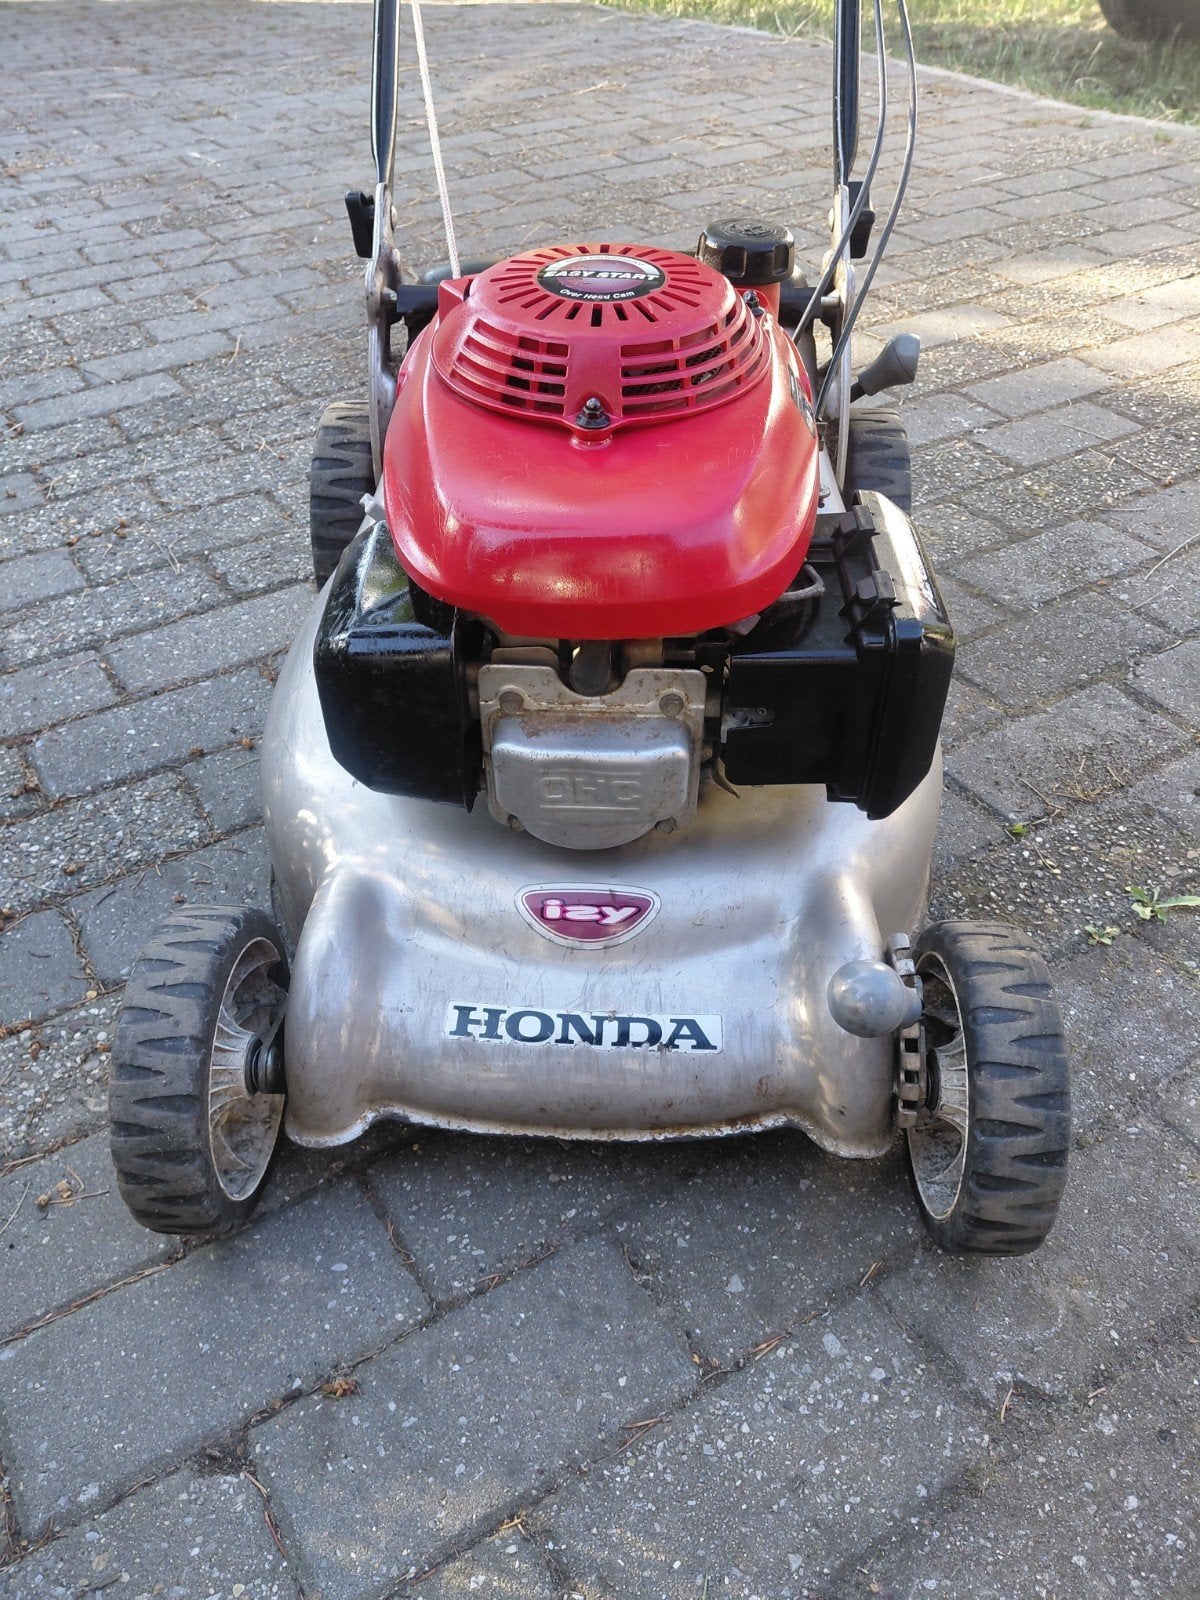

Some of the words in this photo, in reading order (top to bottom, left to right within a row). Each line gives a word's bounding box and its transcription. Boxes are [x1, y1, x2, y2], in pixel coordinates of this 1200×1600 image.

[543, 270, 596, 278] EASY
[596, 271, 660, 280] START
[560, 289, 582, 298] Over
[537, 776, 641, 803] OHC
[543, 898, 639, 925] izy
[449, 1005, 718, 1050] HONDA
